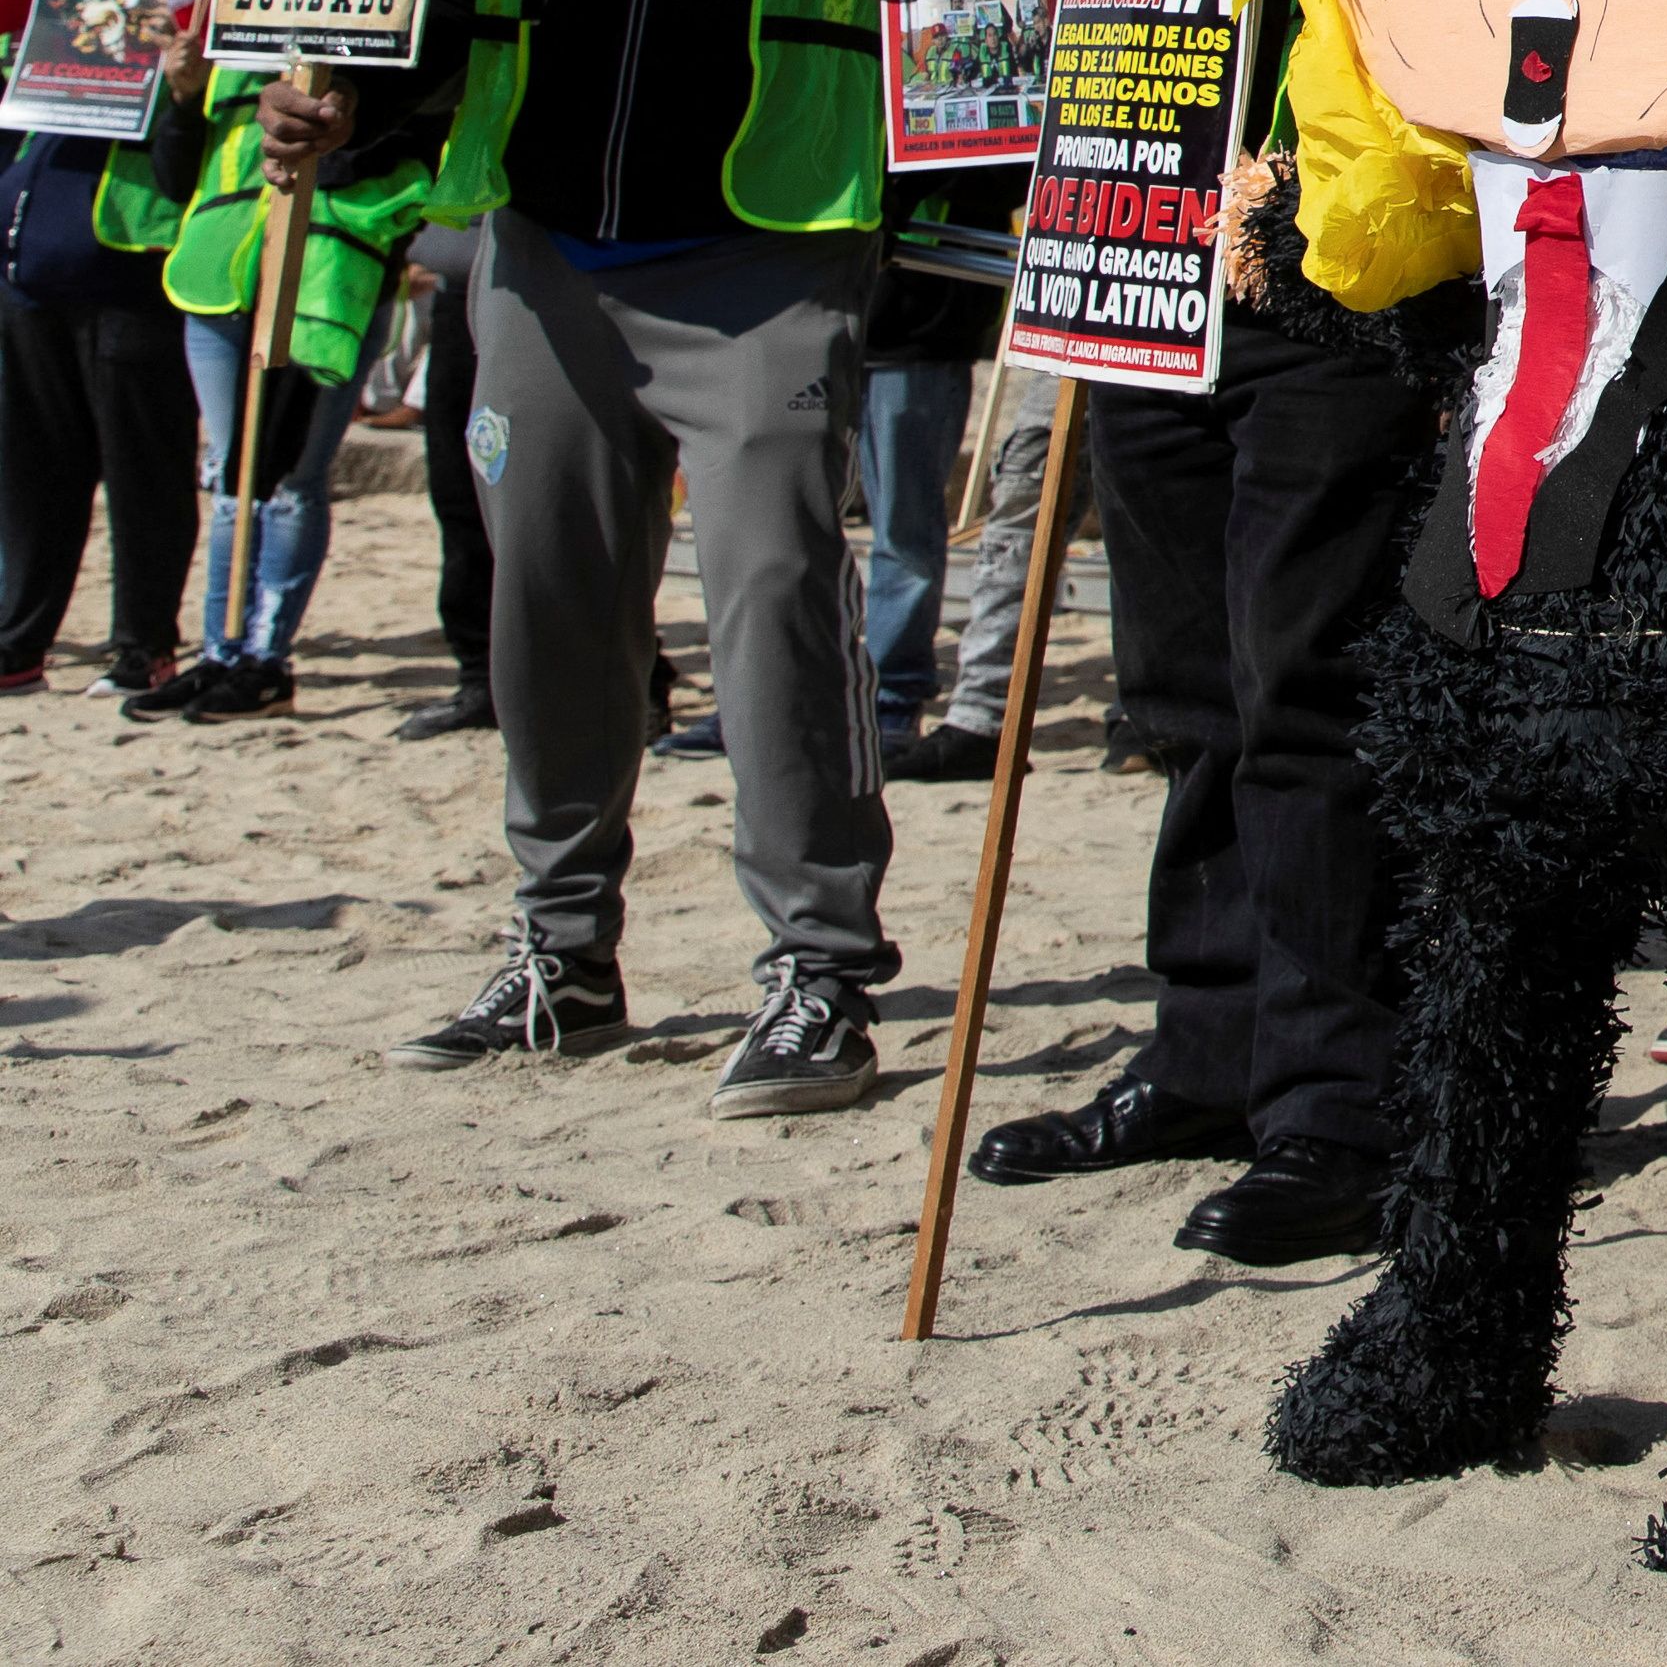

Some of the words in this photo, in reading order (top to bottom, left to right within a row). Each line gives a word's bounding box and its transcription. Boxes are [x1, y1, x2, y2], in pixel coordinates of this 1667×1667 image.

[1057, 23, 1149, 46] LEGALIZACION
[1153, 25, 1180, 48] DE
[1184, 26, 1231, 51] LOS
[1054, 50, 1079, 72] MAS
[1080, 50, 1099, 72] DE
[1099, 51, 1114, 72] 11
[1115, 51, 1224, 79] MILLONES
[1051, 77, 1073, 98] DE
[1075, 77, 1220, 107] MEXICANOS
[1060, 103, 1079, 125] EN
[1080, 104, 1100, 126] LOS
[1101, 105, 1133, 129] E.E.
[1139, 107, 1181, 132] U.U.
[1053, 135, 1128, 171] PROMETIDA
[1132, 140, 1182, 175] POR
[1029, 175, 1078, 232] JOE
[1077, 179, 1218, 246] BIDEN
[1027, 237, 1063, 269] QUIEN
[1063, 236, 1095, 273] GANÓ
[1099, 246, 1201, 283] GRACIAS
[1016, 270, 1035, 311] AL
[1040, 274, 1081, 319] VOTO
[1085, 280, 1206, 333] LATINO
